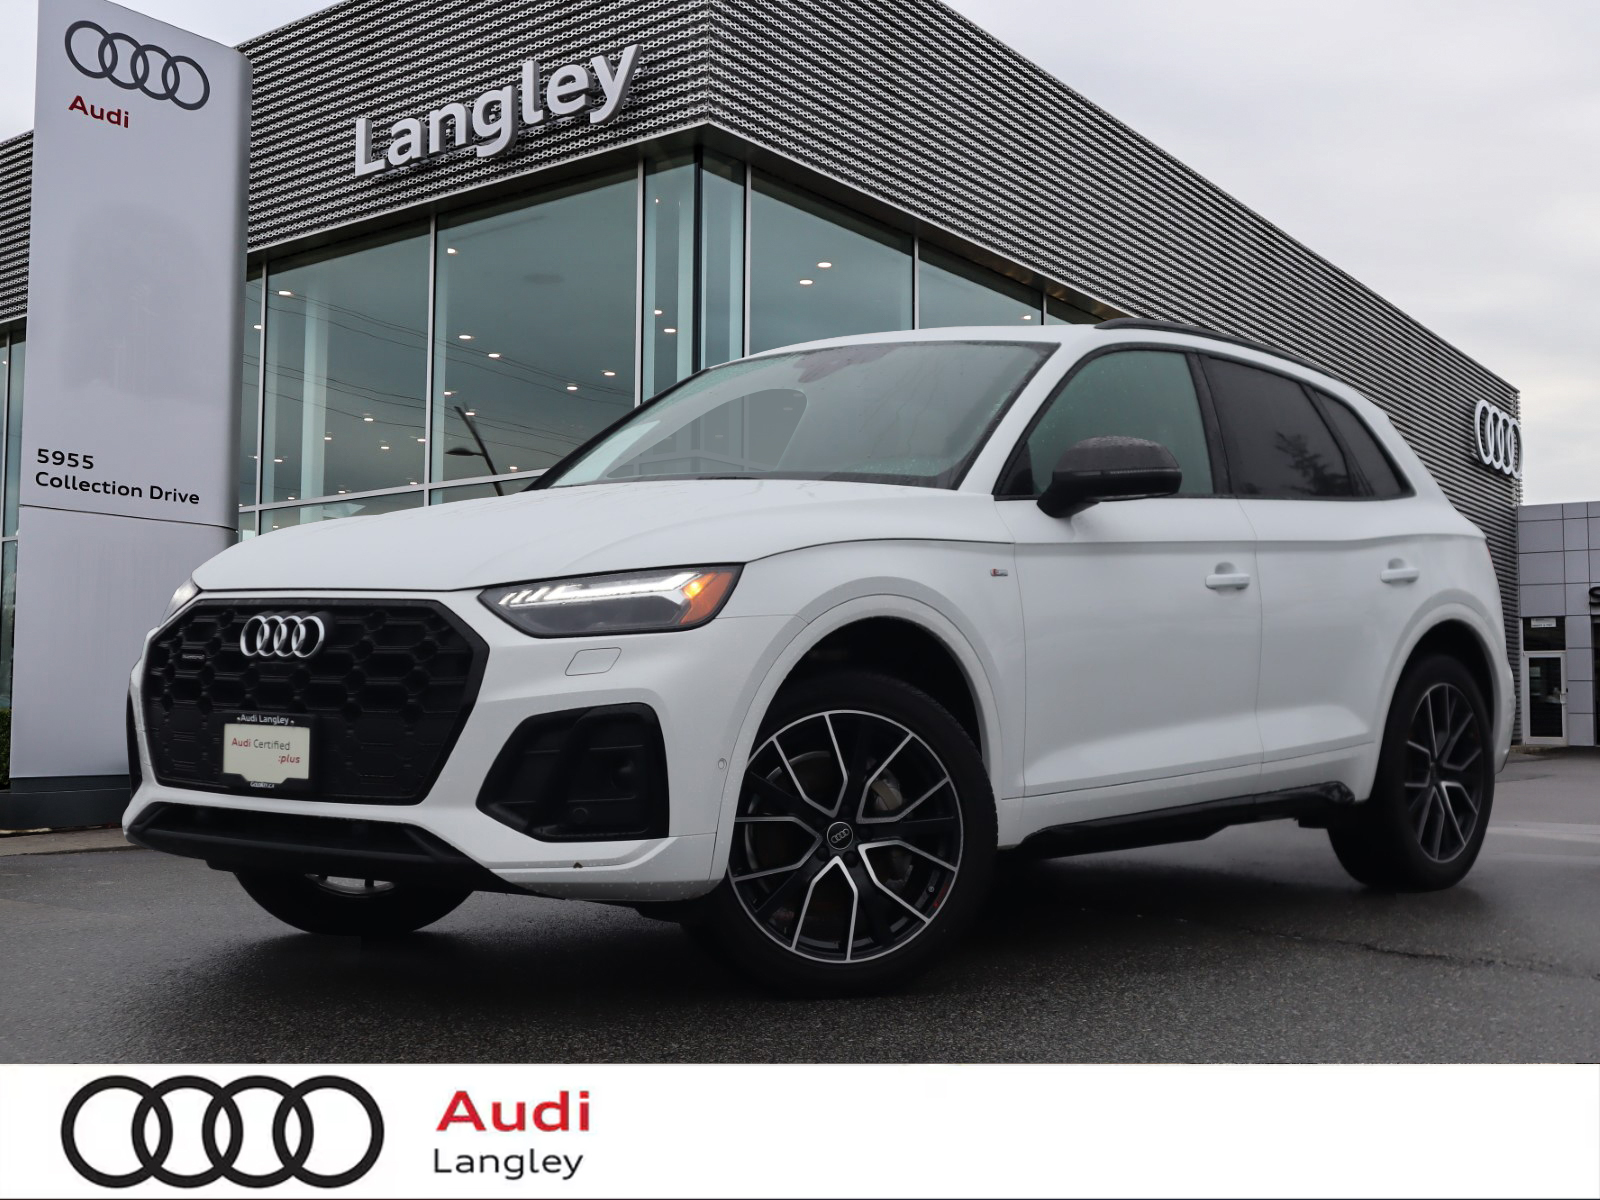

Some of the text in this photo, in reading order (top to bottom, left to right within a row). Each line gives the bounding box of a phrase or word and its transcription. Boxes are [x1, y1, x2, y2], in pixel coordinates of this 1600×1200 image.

[69, 95, 129, 128] Audi
[355, 44, 641, 177] Langley
[37, 448, 94, 469] 5955
[35, 471, 200, 504] Collection Drive
[241, 714, 289, 725] Audi Langley
[231, 737, 290, 750] Audi Certified
